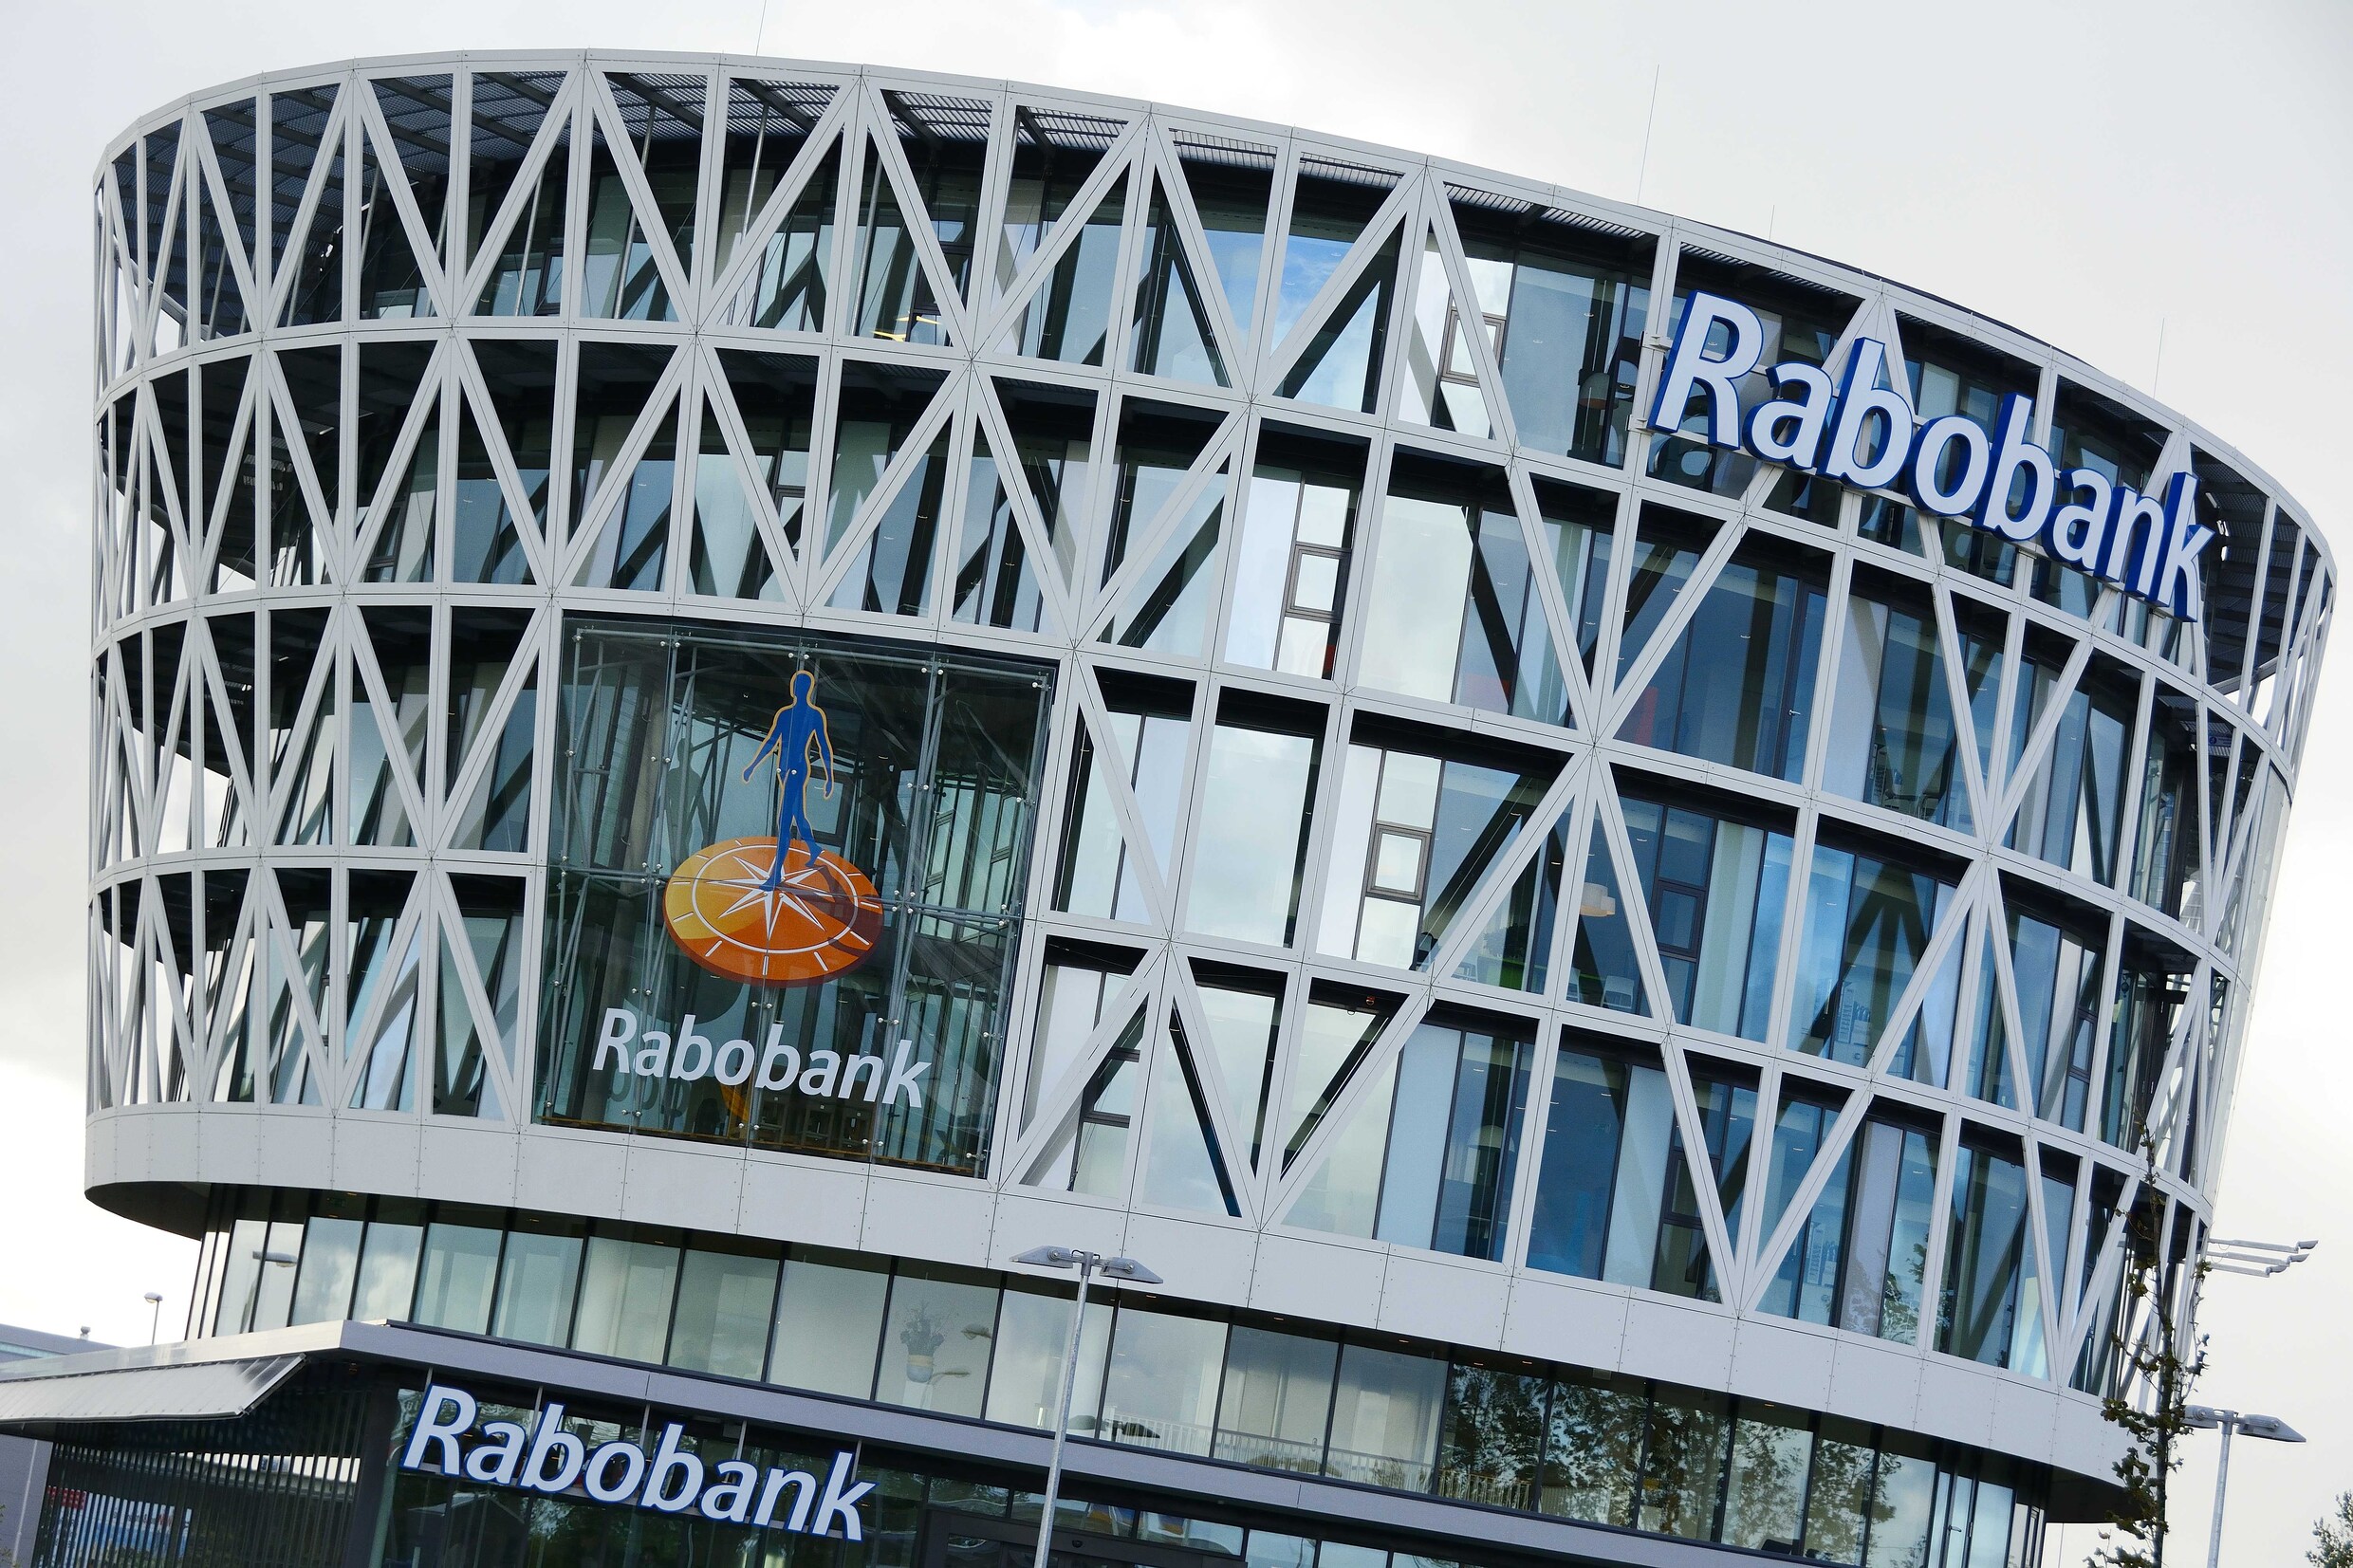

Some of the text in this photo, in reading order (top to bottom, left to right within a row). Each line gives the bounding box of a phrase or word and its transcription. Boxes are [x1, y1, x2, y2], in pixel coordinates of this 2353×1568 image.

[1647, 290, 2214, 622] Rabobank
[593, 1007, 933, 1108] Rabobank
[399, 1383, 878, 1541] Rabobank
